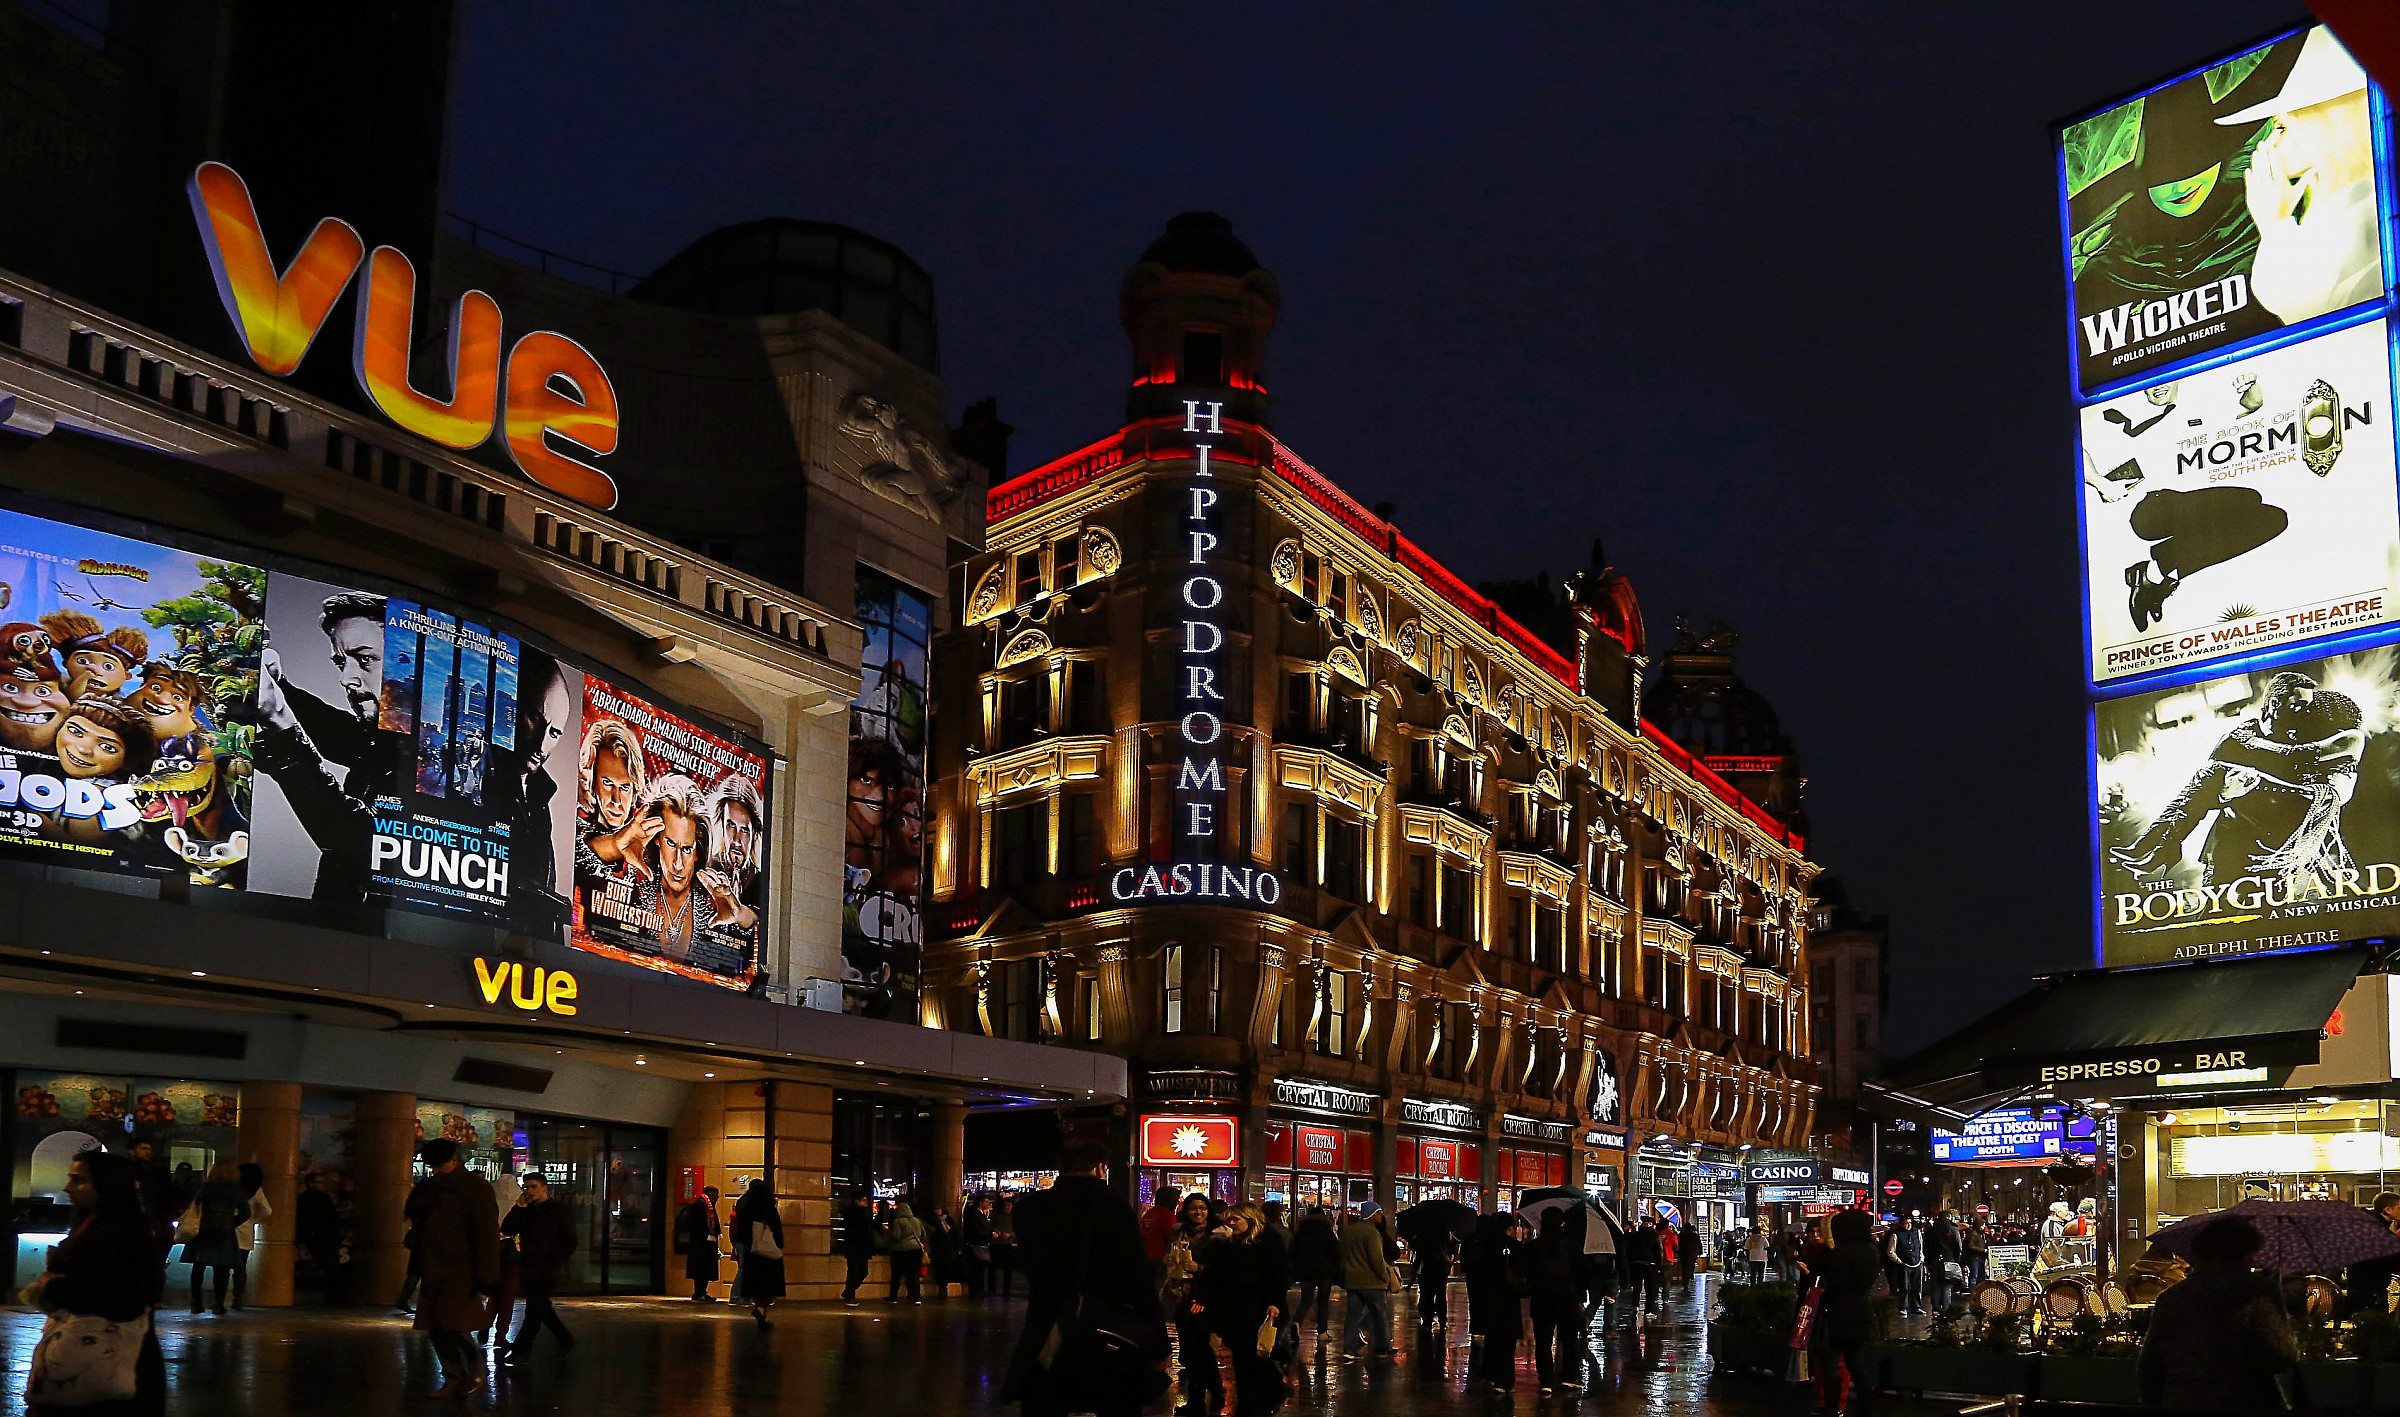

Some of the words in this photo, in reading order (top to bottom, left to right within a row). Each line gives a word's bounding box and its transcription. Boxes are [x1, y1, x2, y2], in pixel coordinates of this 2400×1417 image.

[2112, 348, 2144, 366] APOLLO
[2145, 335, 2186, 355] VICTORIA
[2187, 322, 2226, 341] THEATRE
[2176, 433, 2208, 451] THE
[2216, 418, 2265, 439] BOOK
[2270, 410, 2295, 425] OF
[2209, 464, 2256, 483] SOUTH
[2259, 453, 2298, 471] PARK
[1, 544, 59, 563] CREATORS
[61, 557, 77, 567] OF
[1177, 400, 1226, 835] HIPPODROME
[388, 617, 398, 627] A
[399, 618, 457, 645] KNOCK-OUT
[456, 636, 490, 655] ACTION
[491, 648, 518, 665] MOVIE
[2107, 640, 2174, 666] PRINCE
[2179, 634, 2206, 650] OF
[2211, 618, 2281, 643] WALES
[2286, 597, 2383, 627] THEATRE
[2108, 660, 2147, 674] WINNER
[2149, 658, 2156, 667] 9
[2156, 652, 2185, 664] TONY
[2234, 629, 2295, 648] INCLUDING
[2298, 622, 2327, 635] BEST
[2330, 611, 2384, 627] MUSICAL
[642, 733, 700, 771] PERFORMANCE
[651, 717, 690, 748] AMAZING!
[690, 735, 713, 759] STEVE
[711, 746, 743, 773] CARELL'S
[742, 760, 761, 780] BEST
[375, 794, 402, 804] JAMES
[12, 810, 43, 828] 3D
[412, 813, 440, 825] ANDREA
[374, 817, 458, 848] WELCOME
[461, 835, 480, 853] TO
[484, 840, 509, 861] THE
[488, 825, 511, 838] STRONG
[24, 838, 61, 849] THEY'LL
[62, 843, 75, 851] BE
[75, 845, 114, 857] HISTORY
[371, 834, 509, 897] PUNCH
[372, 874, 394, 884] FROM
[394, 878, 431, 891] EXECUTIVE
[431, 884, 466, 898] PRODUCER
[466, 891, 489, 903] RIDLEY
[489, 895, 507, 907] SCOTT
[606, 881, 633, 905] BURT
[1111, 863, 1280, 905] CASINO
[2114, 863, 2400, 926] BODYGUARD
[2145, 879, 2174, 892] THE
[591, 889, 664, 932] WONDERSTONE
[2268, 909, 2279, 920] A
[2284, 904, 2320, 918] NEW
[2325, 895, 2400, 913] MUSICAL
[2174, 939, 2248, 959] ADELPHI
[2256, 930, 2340, 949] THEATRE
[2041, 1058, 2161, 1082] ESPRESSO
[2196, 1051, 2247, 1070] BAR
[1148, 1077, 1238, 1093] AMUSEMENTS
[1277, 1085, 1329, 1108] CRYSTAL
[1332, 1092, 1370, 1113] ROOMS
[1405, 1104, 1446, 1125] CRYSTAL
[1503, 1119, 1536, 1136] CRYSTAL
[1538, 1124, 1563, 1140] ROOMS
[1994, 1122, 2003, 1135] &
[2003, 1120, 2058, 1134] DISCOUNT
[1305, 1133, 1337, 1150] CRYSTAL
[1951, 1135, 2001, 1148] THEATRE
[2001, 1133, 2041, 1144] TICKET
[1978, 1145, 2014, 1155] BOOTH
[1309, 1149, 1333, 1165] BINGO
[1586, 1171, 1610, 1185] HELIOT
[1692, 1176, 1717, 1185] HALF
[1751, 1166, 1812, 1179] CASINO
[1692, 1184, 1717, 1192] PRICE
